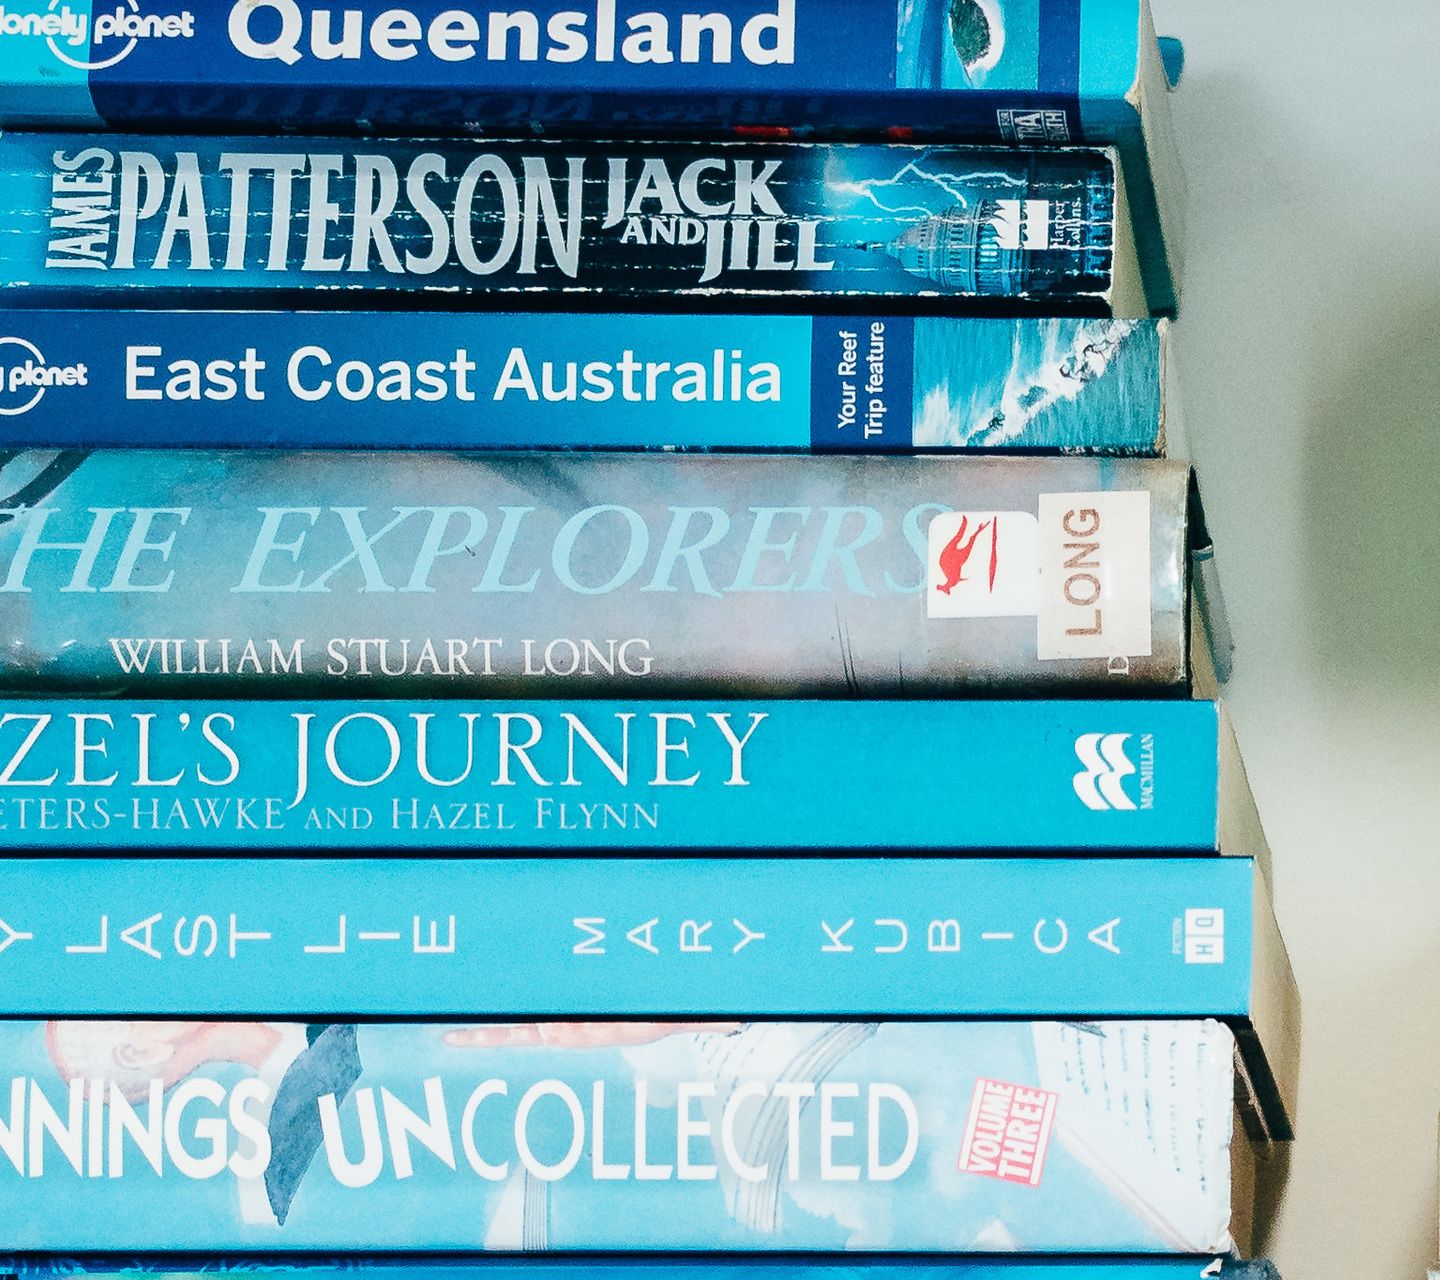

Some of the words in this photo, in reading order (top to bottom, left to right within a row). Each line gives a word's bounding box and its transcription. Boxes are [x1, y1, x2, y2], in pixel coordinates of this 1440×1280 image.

[94, 6, 195, 44] planet
[228, 0, 796, 65] Queensland
[46, 147, 114, 270] JAMES
[114, 152, 584, 278] PATTERSON
[602, 158, 784, 229] JACK
[620, 216, 706, 246] AND
[699, 220, 835, 283] JILL
[9, 360, 88, 392] planet
[126, 345, 265, 400] East
[287, 346, 475, 401] Coast
[494, 347, 781, 402] Australia
[838, 330, 858, 376] Reef
[864, 321, 886, 394] feature
[837, 383, 857, 429] Your
[864, 397, 888, 439] Trip
[0, 502, 191, 592] HE
[230, 502, 954, 598] EXPLORERS
[1063, 508, 1102, 637] LONG
[109, 637, 303, 675] WILLIAM
[326, 637, 502, 677] STUART
[523, 638, 655, 676] LONG
[287, 712, 769, 809] JOURNEY
[1140, 733, 1154, 810] MACMILLAN
[65, 912, 272, 959] LAST
[304, 914, 456, 954] LIE
[572, 917, 766, 955] MARY
[820, 916, 1121, 954] KUBICA
[967, 1080, 1014, 1173] VOLUME
[998, 1086, 1047, 1178] THREE
